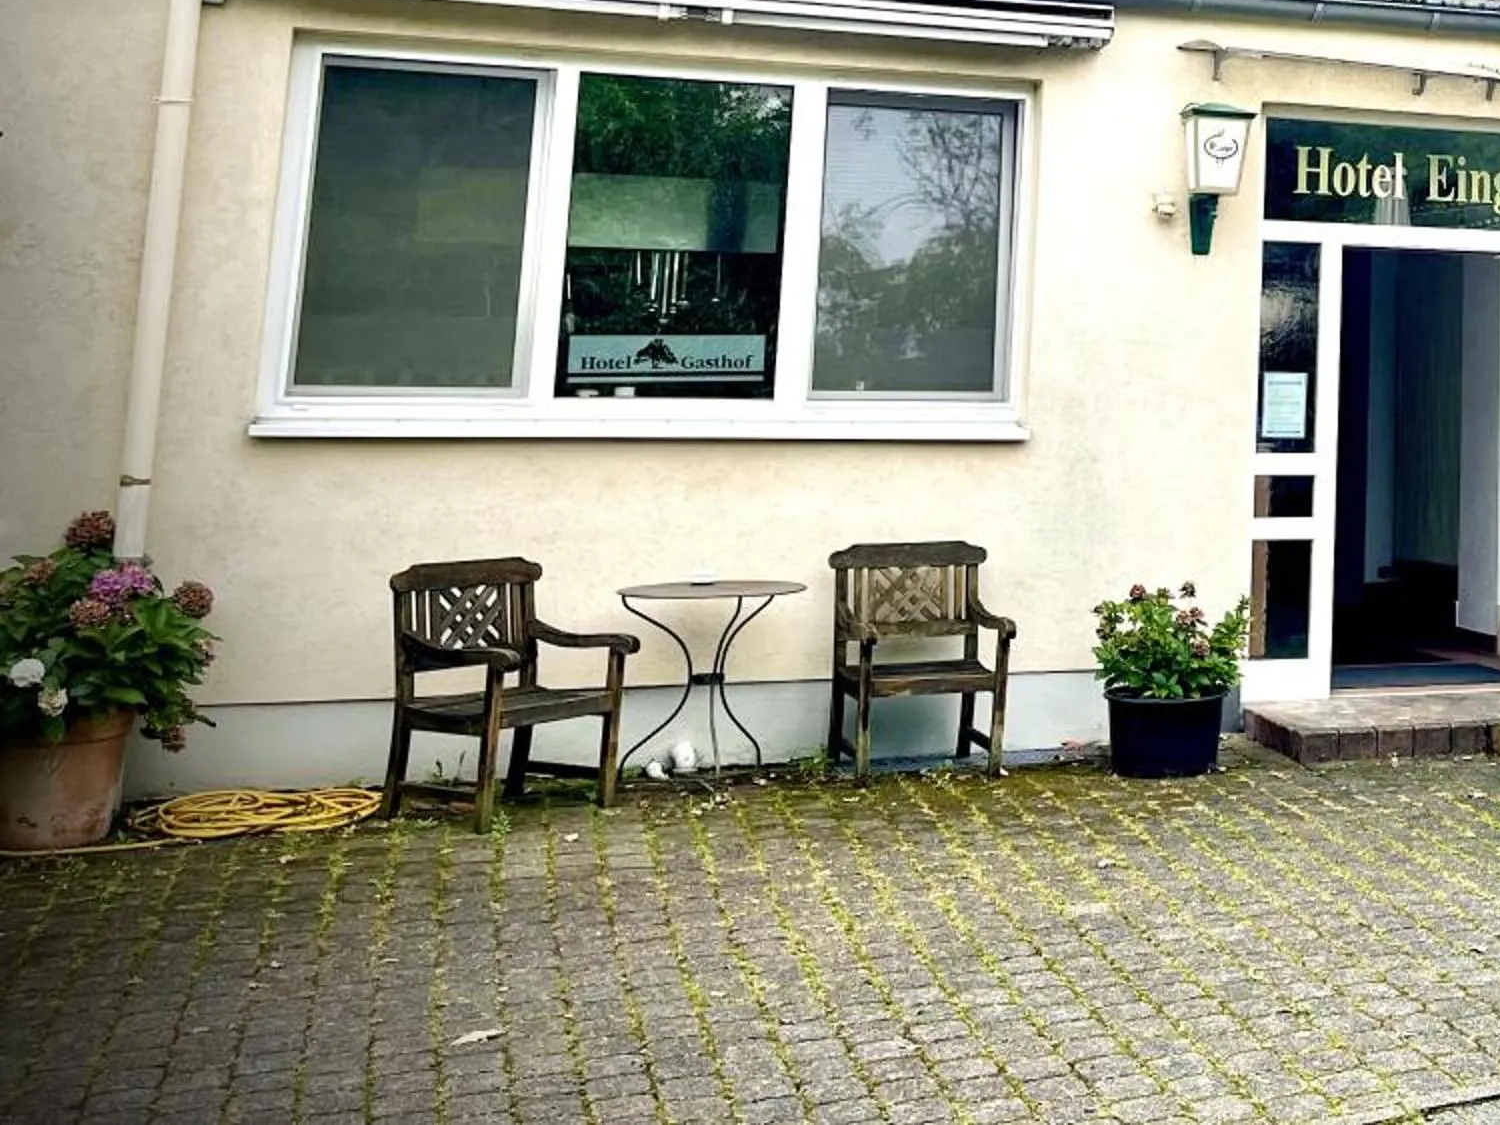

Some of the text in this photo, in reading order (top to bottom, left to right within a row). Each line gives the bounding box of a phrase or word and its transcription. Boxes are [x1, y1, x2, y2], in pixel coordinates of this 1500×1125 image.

[1292, 144, 1406, 201] Hotel
[580, 354, 754, 371] Hotel Gasthof
